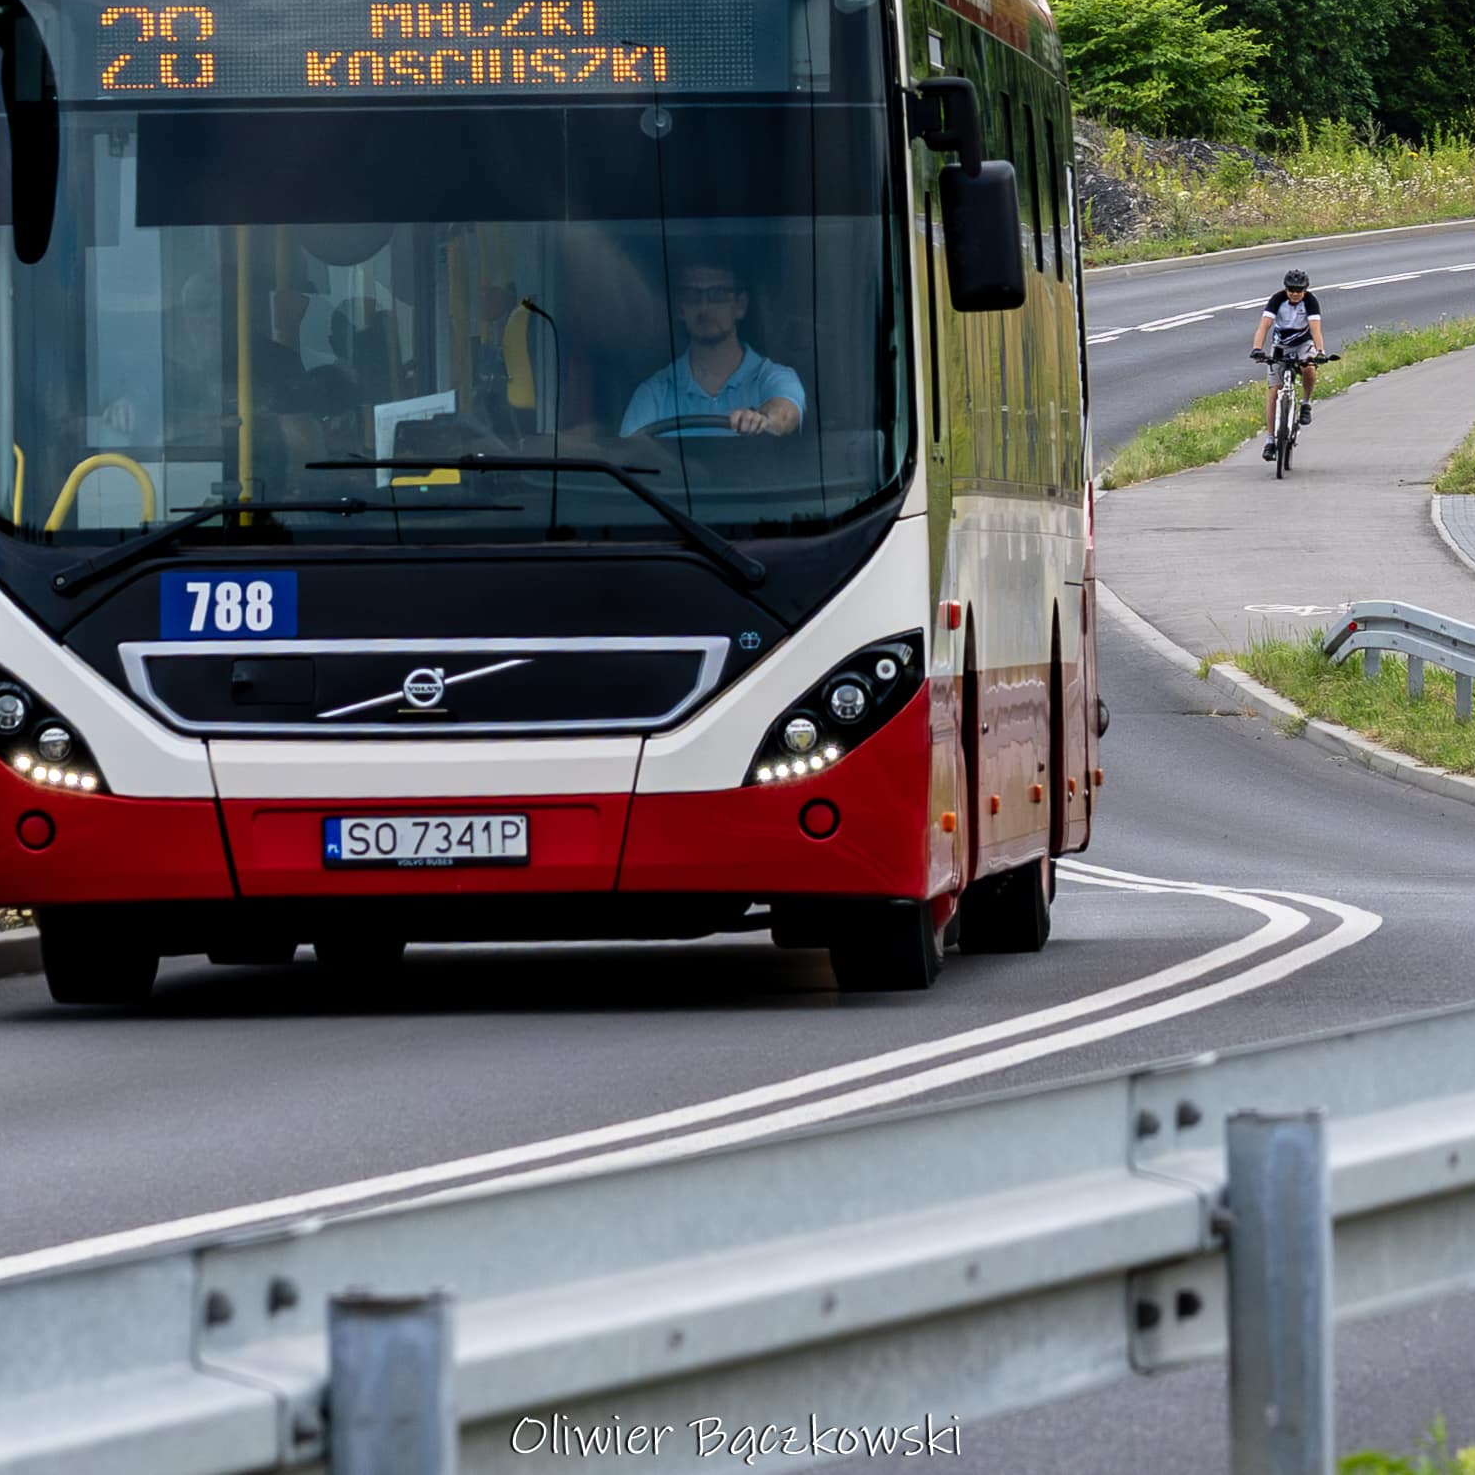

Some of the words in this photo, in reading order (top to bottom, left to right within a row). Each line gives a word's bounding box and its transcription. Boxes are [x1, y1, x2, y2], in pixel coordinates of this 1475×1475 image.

[186, 580, 274, 632] 788
[407, 685, 442, 693] VOLVO
[348, 822, 397, 856] SO
[411, 819, 521, 856] 7341P
[327, 844, 340, 854] PL
[397, 859, 424, 867] VOLVO
